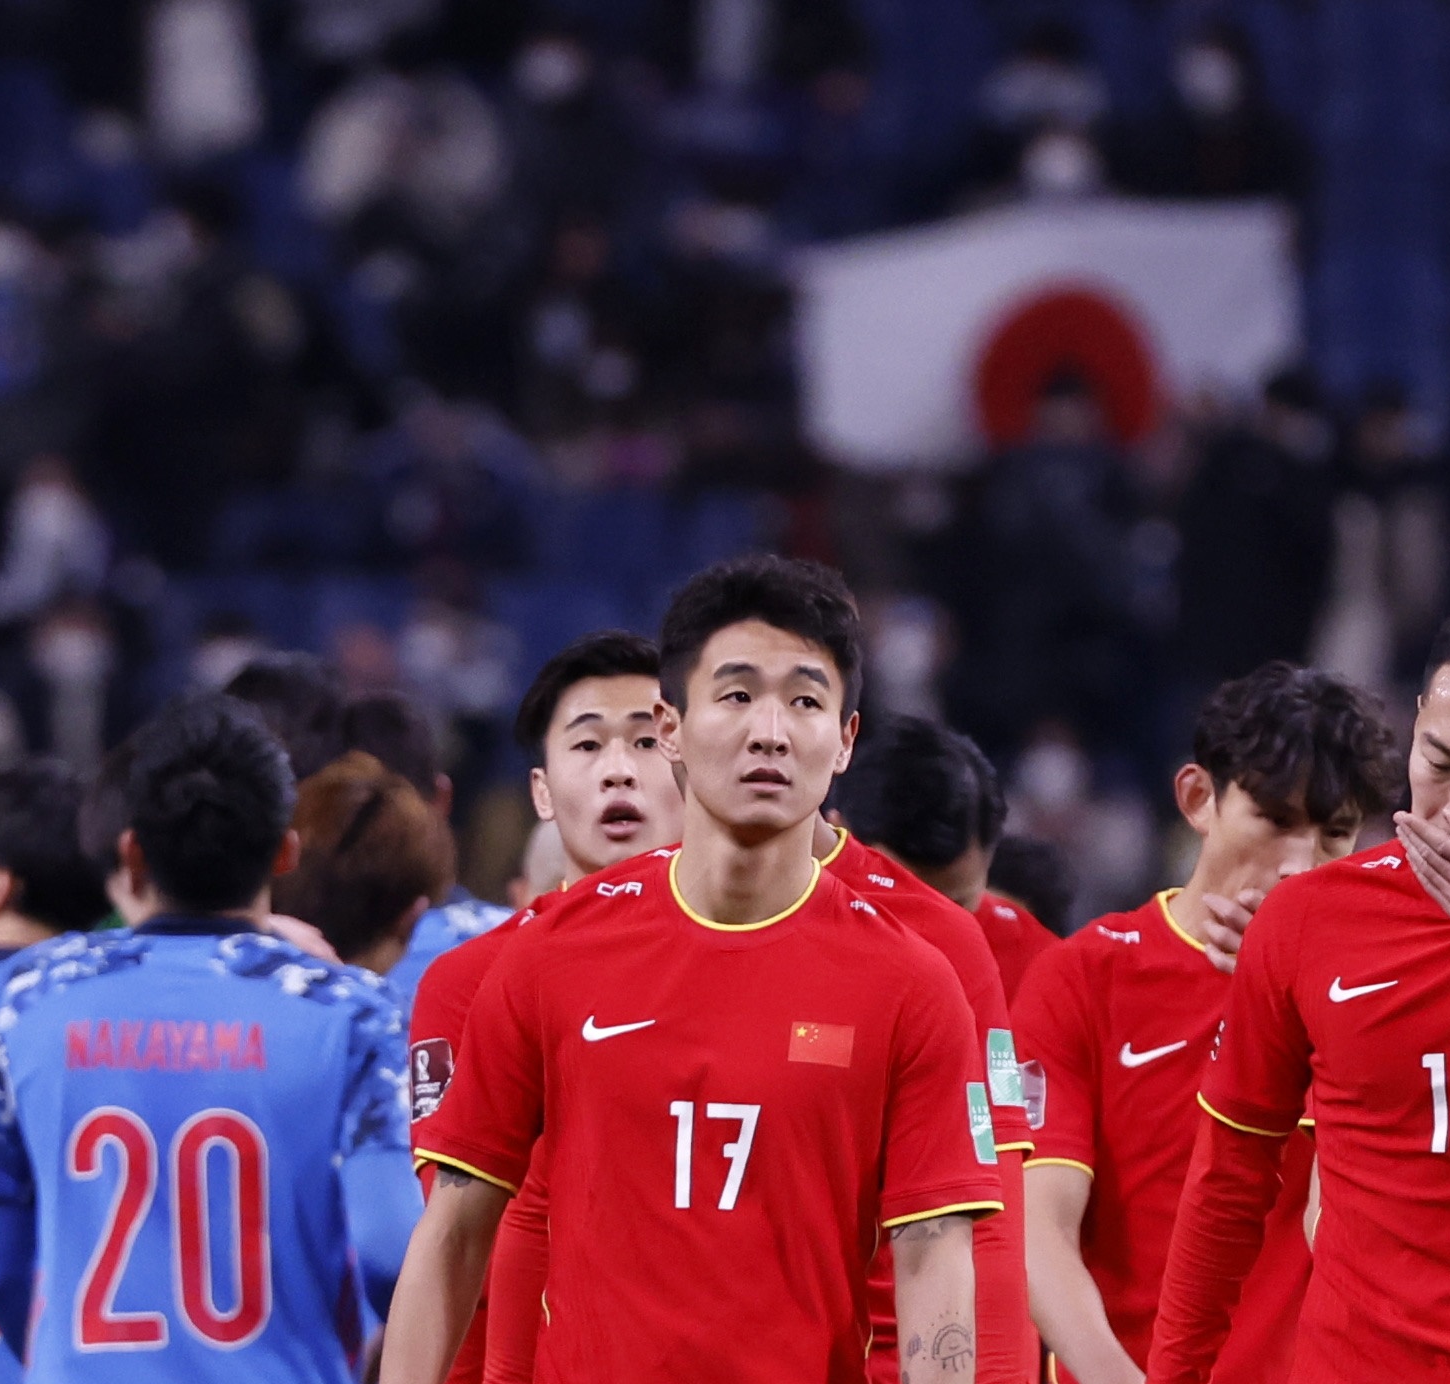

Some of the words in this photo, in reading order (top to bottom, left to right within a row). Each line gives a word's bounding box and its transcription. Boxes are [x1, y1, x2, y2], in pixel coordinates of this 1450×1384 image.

[65, 1019, 267, 1072] NAKAYAMA
[669, 1100, 763, 1211] 17
[66, 1104, 273, 1352] 20
